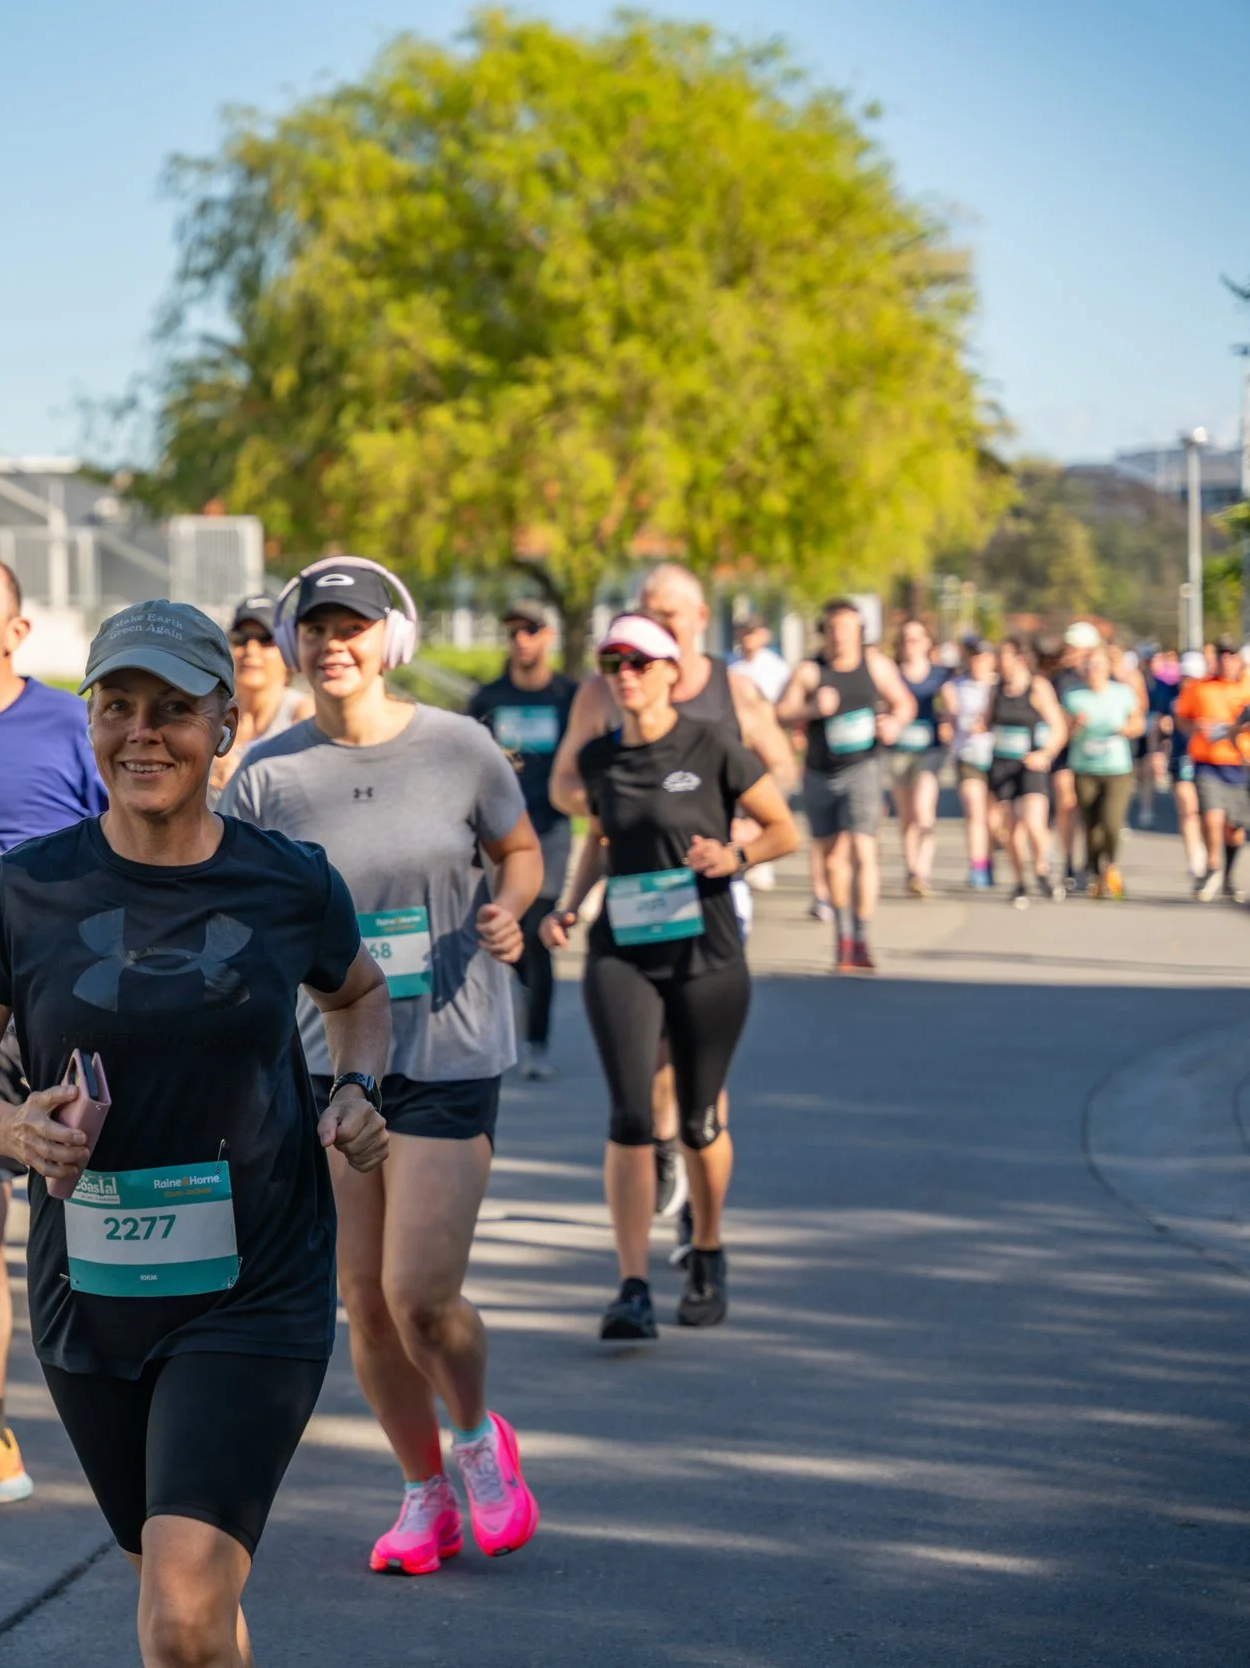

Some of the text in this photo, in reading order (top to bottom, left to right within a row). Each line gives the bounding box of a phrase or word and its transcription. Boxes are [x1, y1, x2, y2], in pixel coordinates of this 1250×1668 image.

[147, 613, 183, 630] Earth
[110, 623, 182, 640] Green Again
[103, 1214, 176, 1241] 2277
